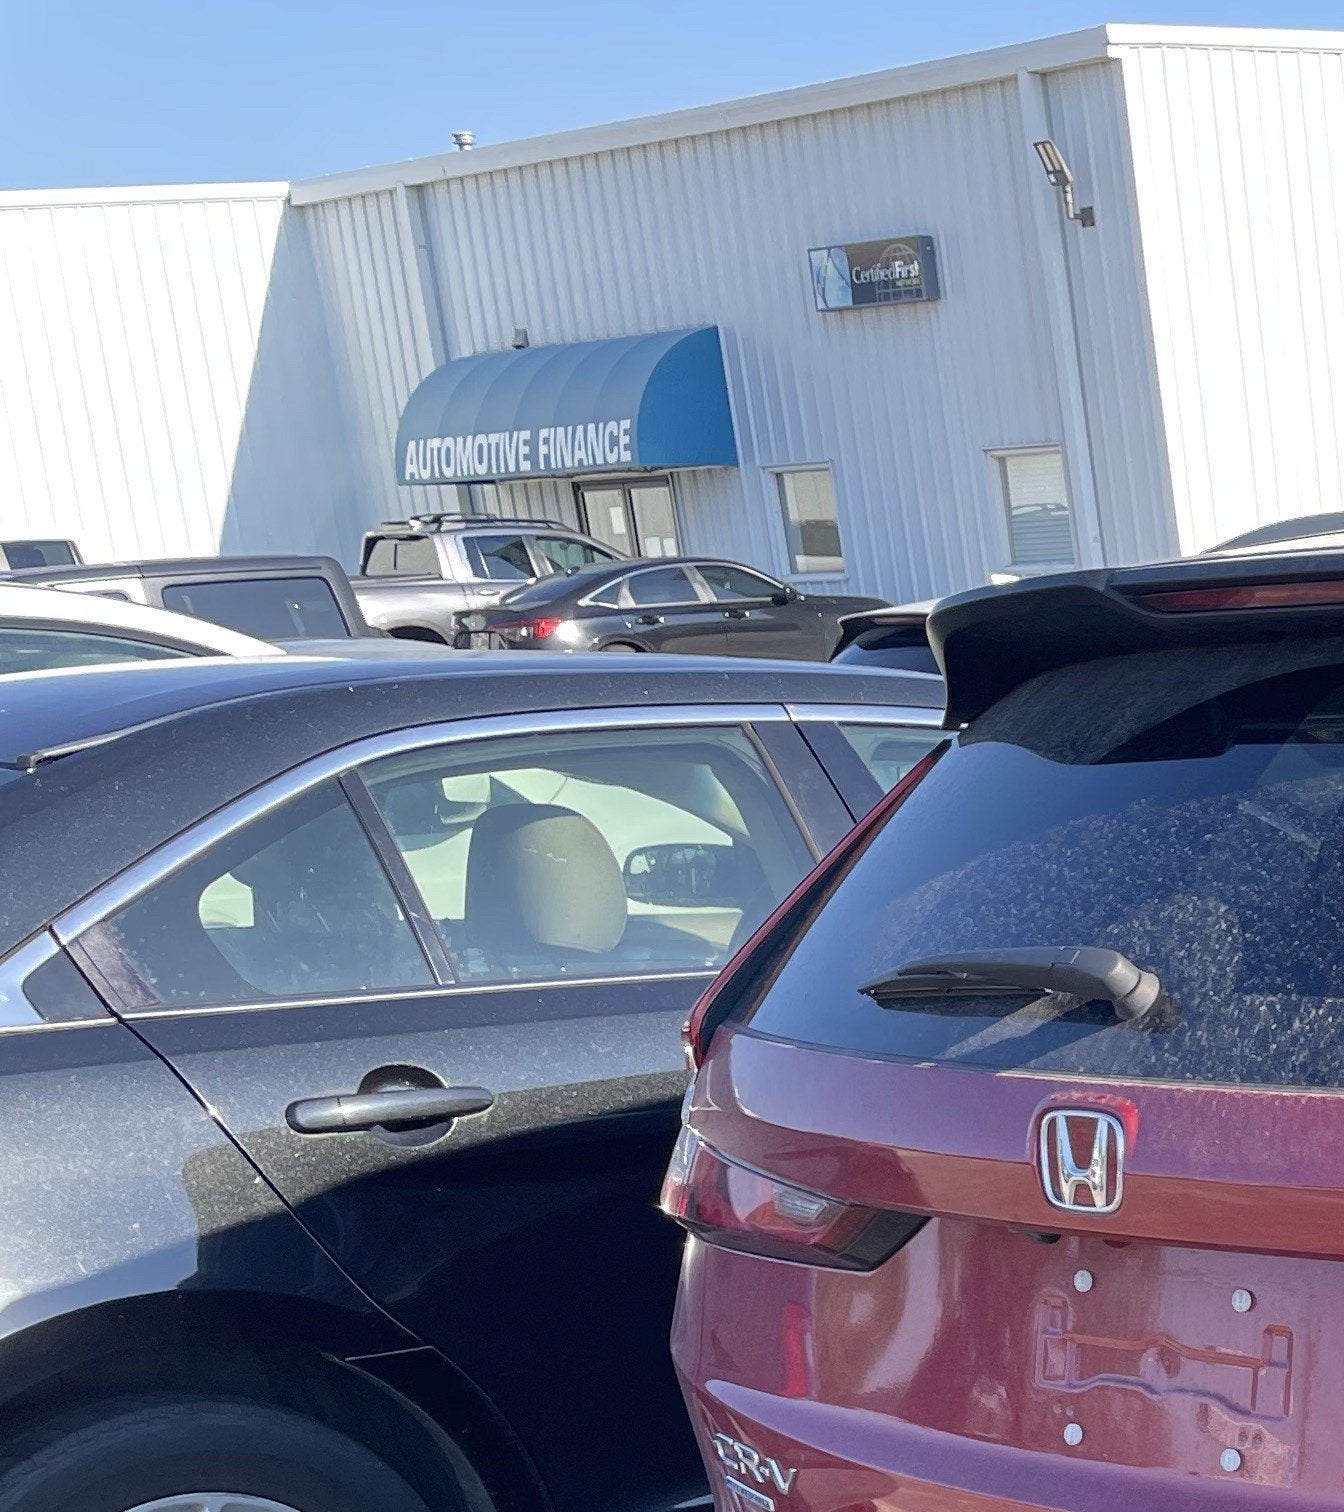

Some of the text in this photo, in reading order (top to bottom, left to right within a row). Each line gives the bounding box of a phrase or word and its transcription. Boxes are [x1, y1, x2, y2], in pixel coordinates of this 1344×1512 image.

[405, 419, 632, 480] AUTOMOTIVE FINANCE
[713, 1432, 798, 1495] CR-V
